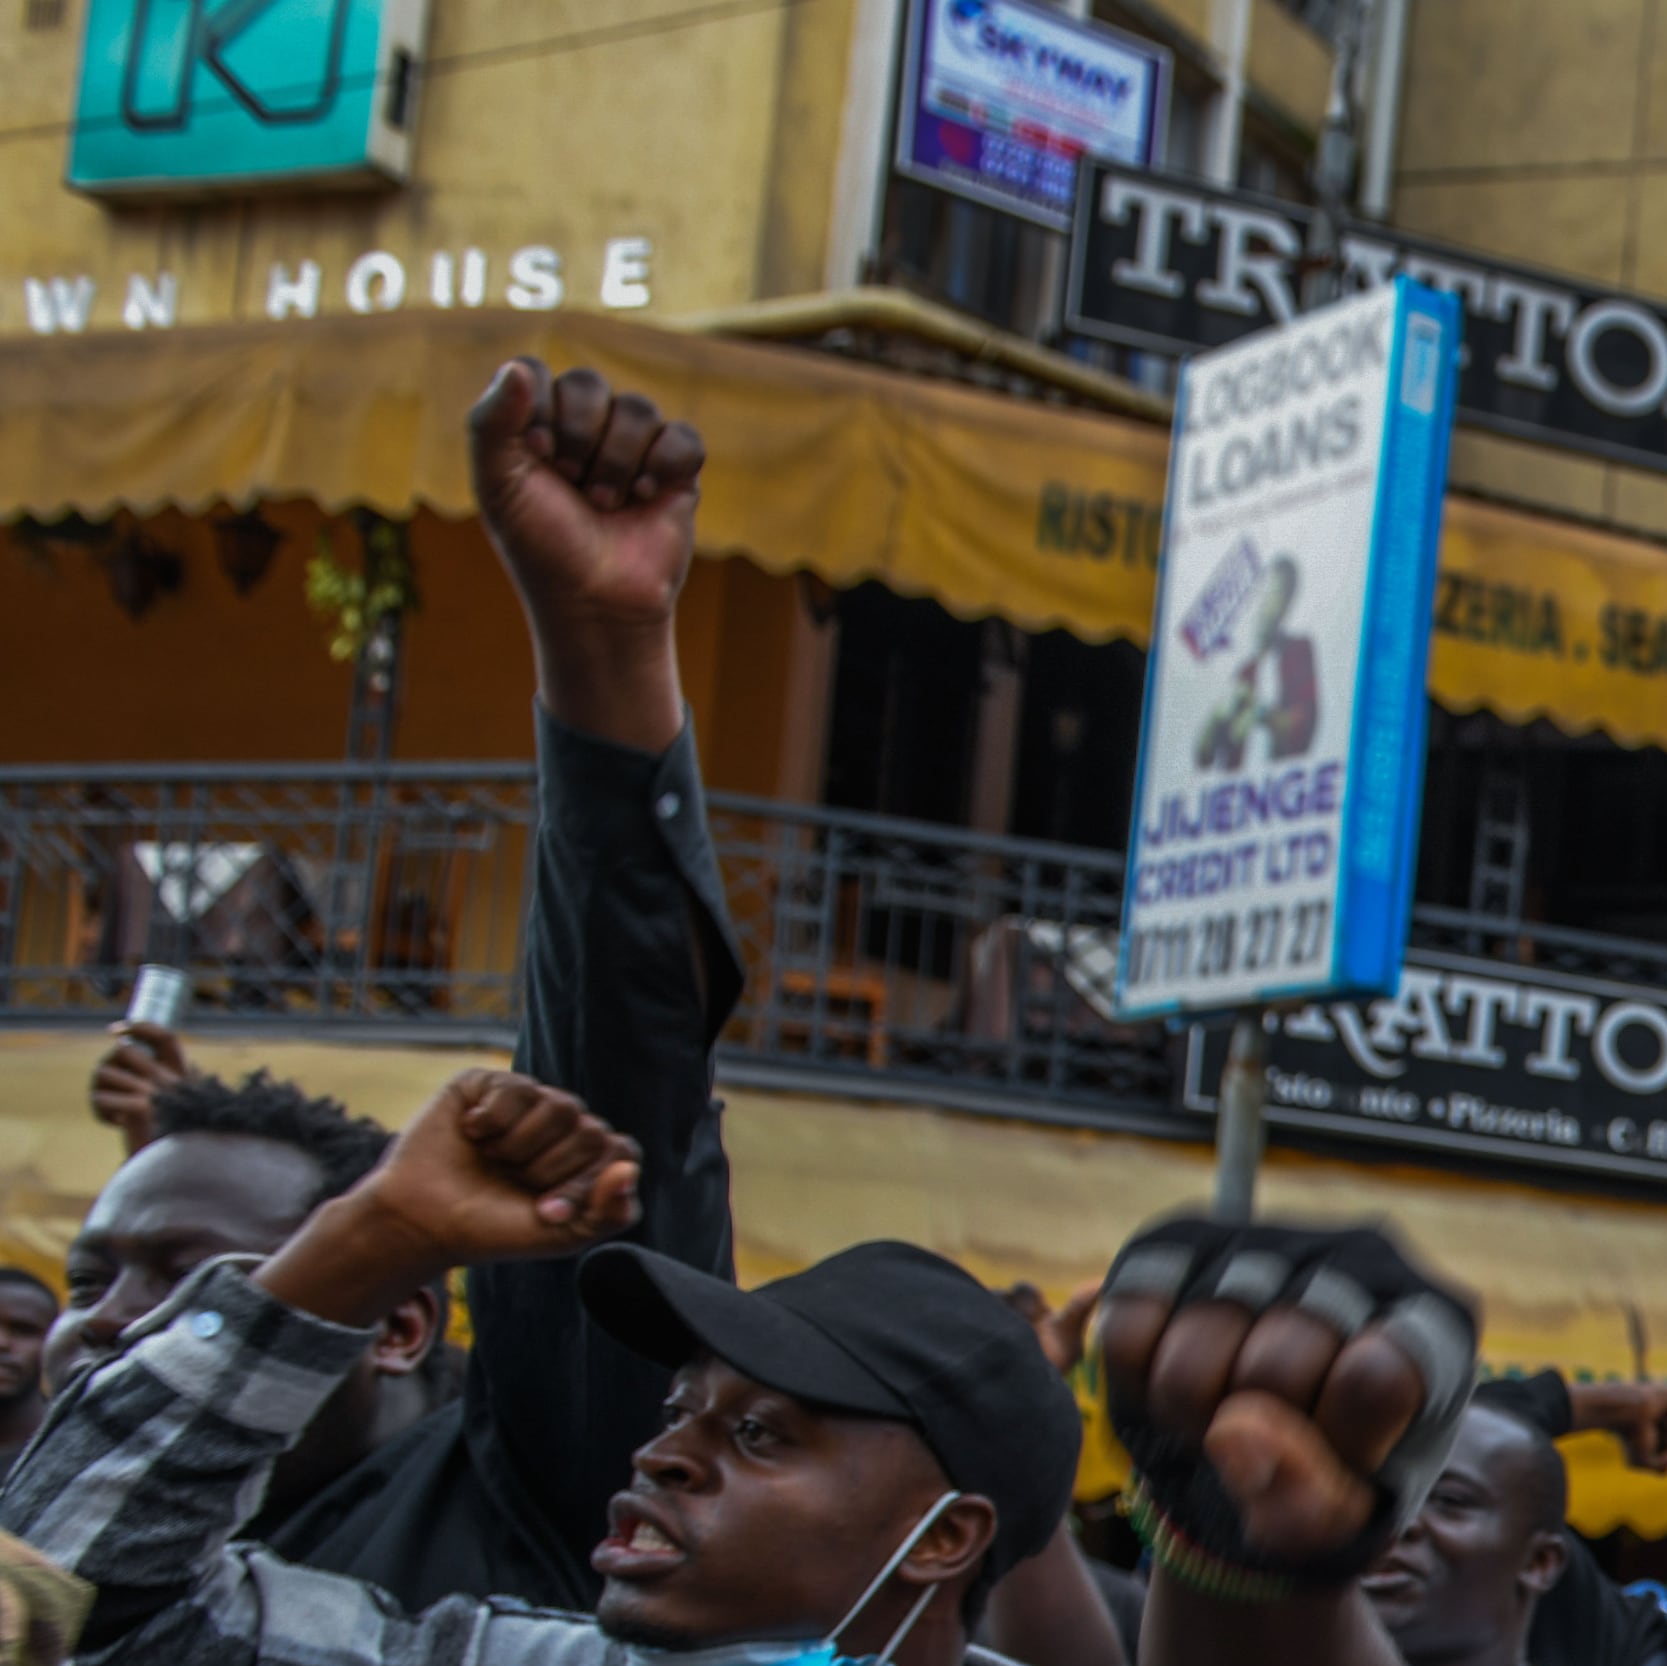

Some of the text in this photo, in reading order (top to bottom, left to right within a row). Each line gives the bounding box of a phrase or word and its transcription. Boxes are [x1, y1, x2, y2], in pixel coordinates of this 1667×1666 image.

[265, 237, 652, 320] HOUSE
[1189, 394, 1361, 508] LOANS
[1136, 828, 1332, 904] CREDIT LTD
